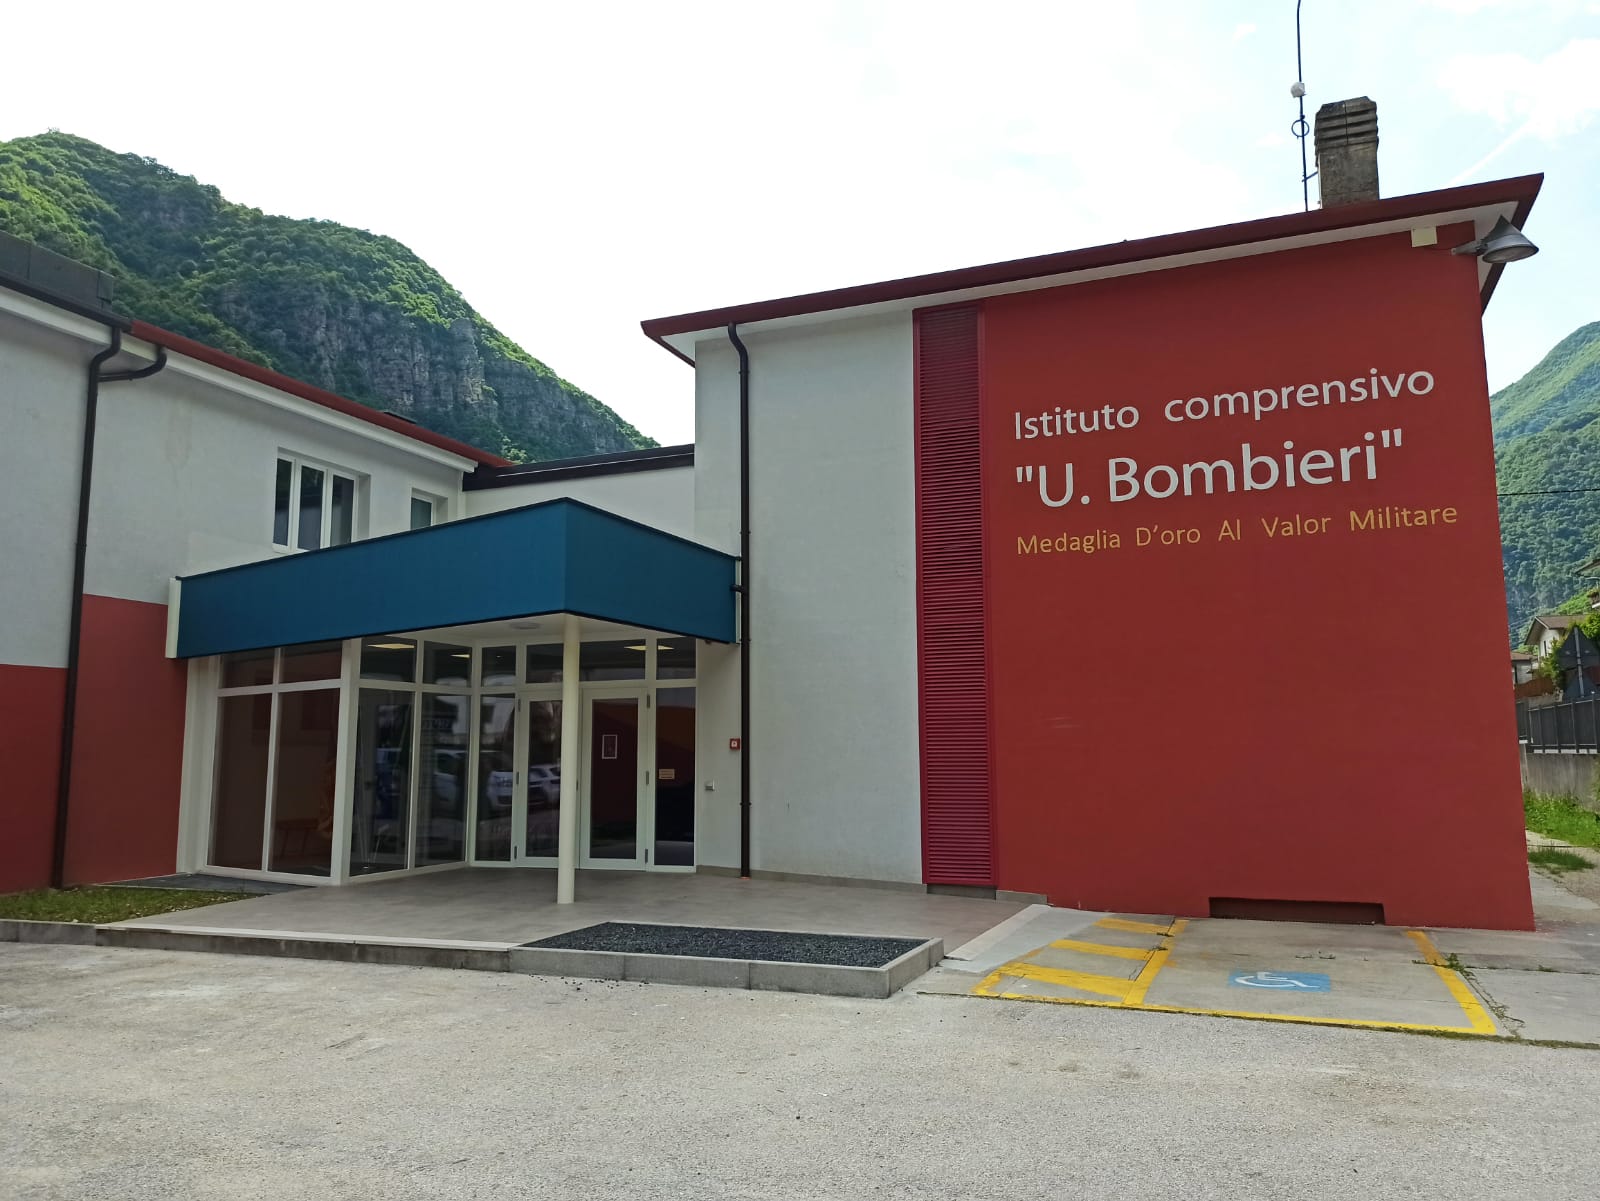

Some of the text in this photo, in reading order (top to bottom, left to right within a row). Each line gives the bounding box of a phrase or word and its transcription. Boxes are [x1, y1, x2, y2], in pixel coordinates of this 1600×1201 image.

[1014, 367, 1435, 440] Istituto comprensivo
[1015, 427, 1404, 508] "U. Bombieri"
[1017, 528, 1122, 556] Medaglia
[1218, 518, 1242, 542] Al
[1261, 513, 1333, 539] Valor
[1349, 505, 1458, 533] Militare
